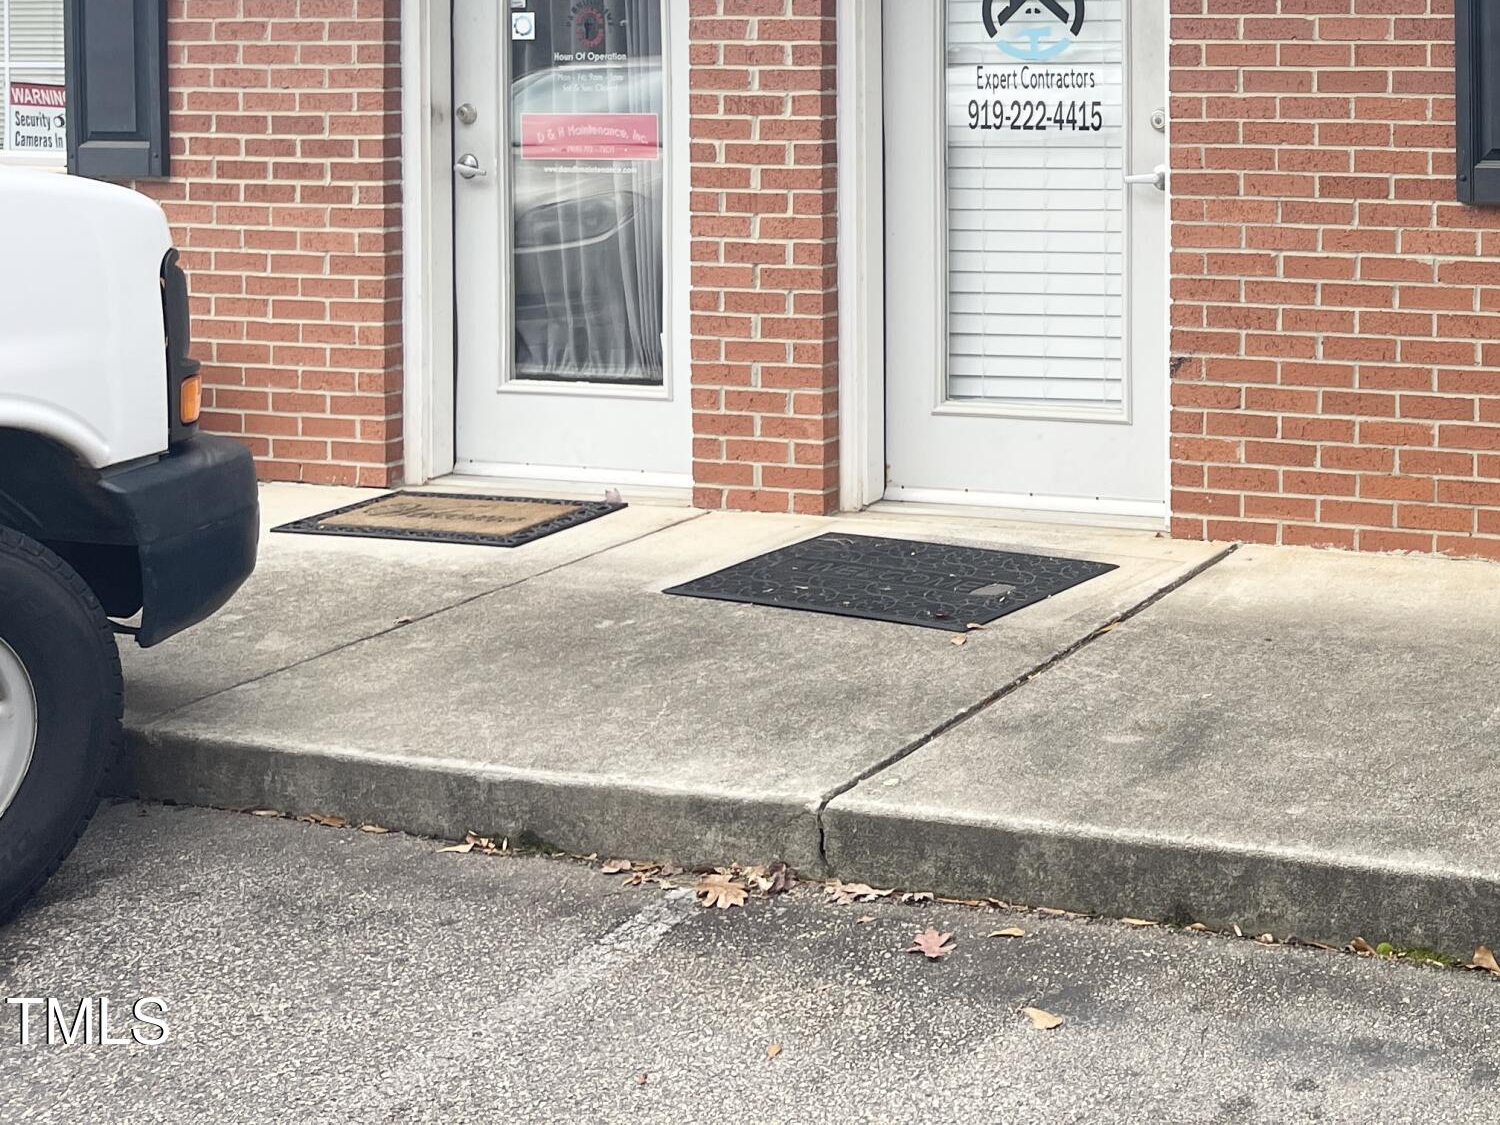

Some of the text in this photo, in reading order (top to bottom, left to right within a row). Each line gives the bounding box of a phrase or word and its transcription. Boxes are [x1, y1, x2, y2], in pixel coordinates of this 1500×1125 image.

[553, 51, 627, 63] Hours Of Operation
[976, 65, 1095, 95] Expert Contractors
[15, 110, 51, 131] Security
[968, 99, 1103, 132] 919-222-4415
[15, 130, 64, 148] Cameras In
